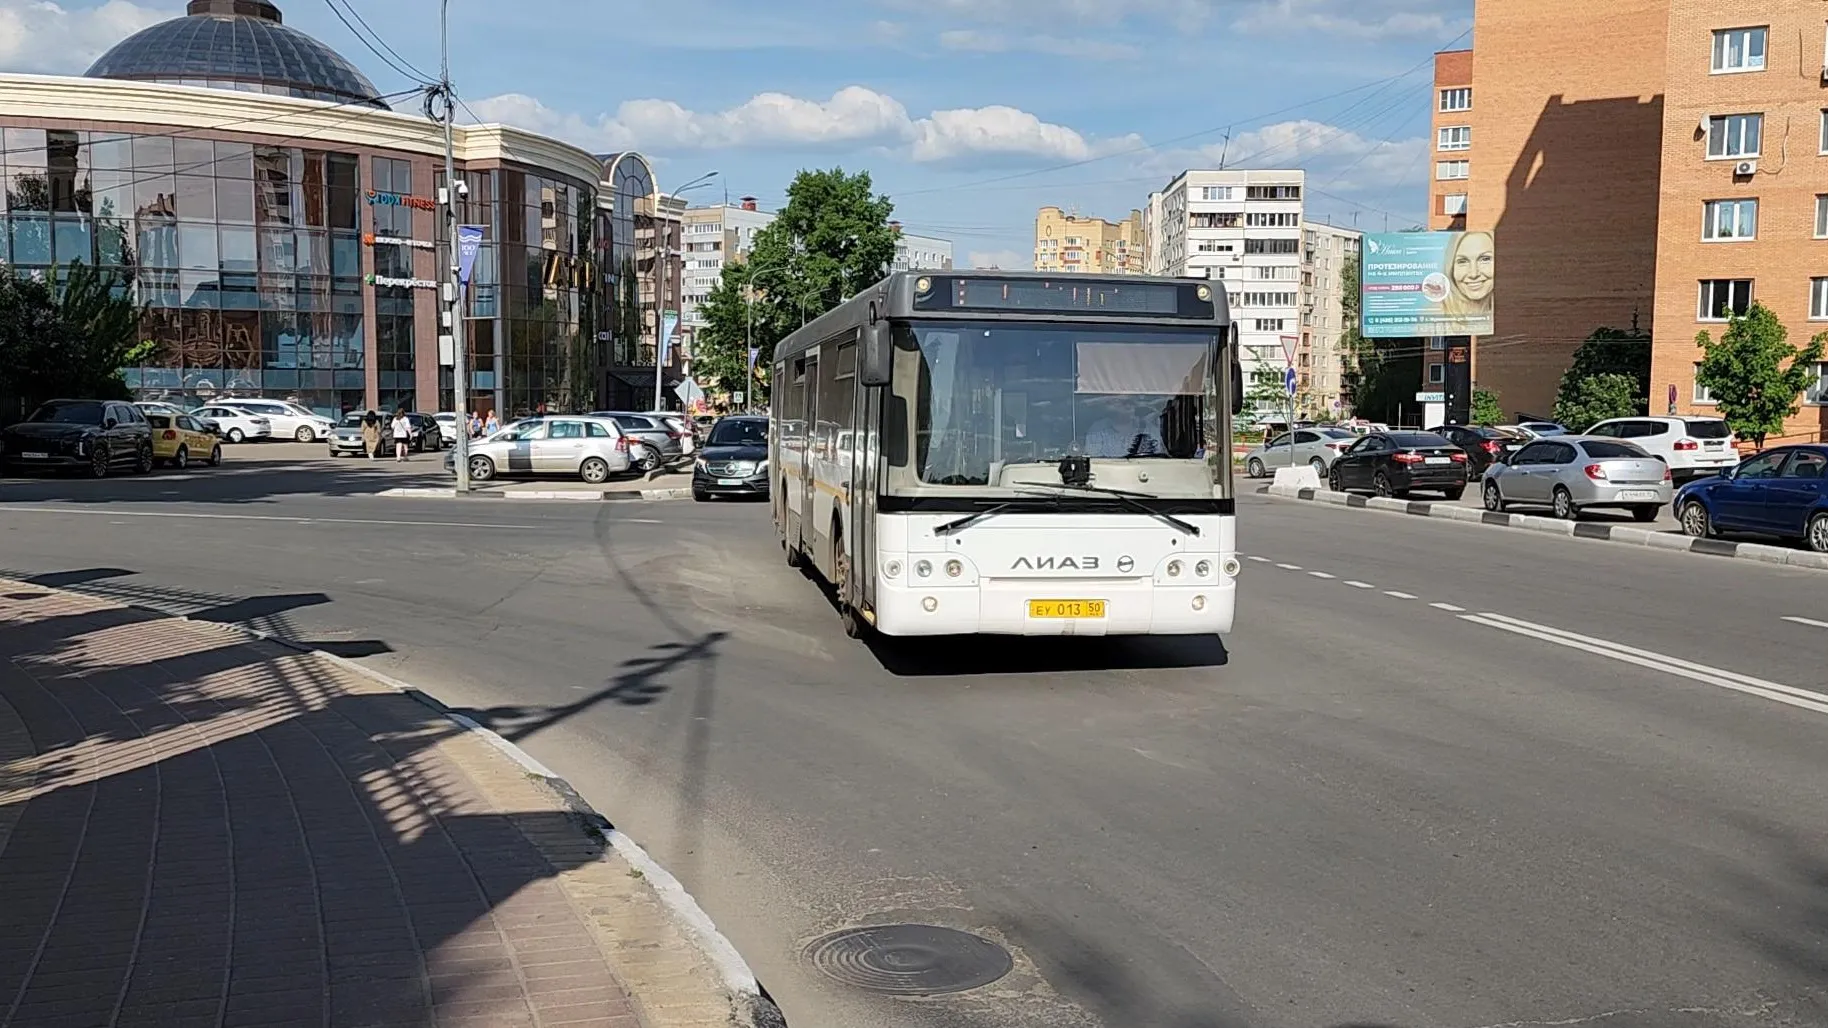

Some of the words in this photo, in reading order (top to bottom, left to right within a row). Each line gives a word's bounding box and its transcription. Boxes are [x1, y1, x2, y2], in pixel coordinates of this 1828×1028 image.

[1010, 556, 1100, 570] ЛИАЗ
[1036, 606, 1051, 615] ЕУ
[1057, 603, 1081, 615] 013
[1088, 602, 1101, 612] 50
